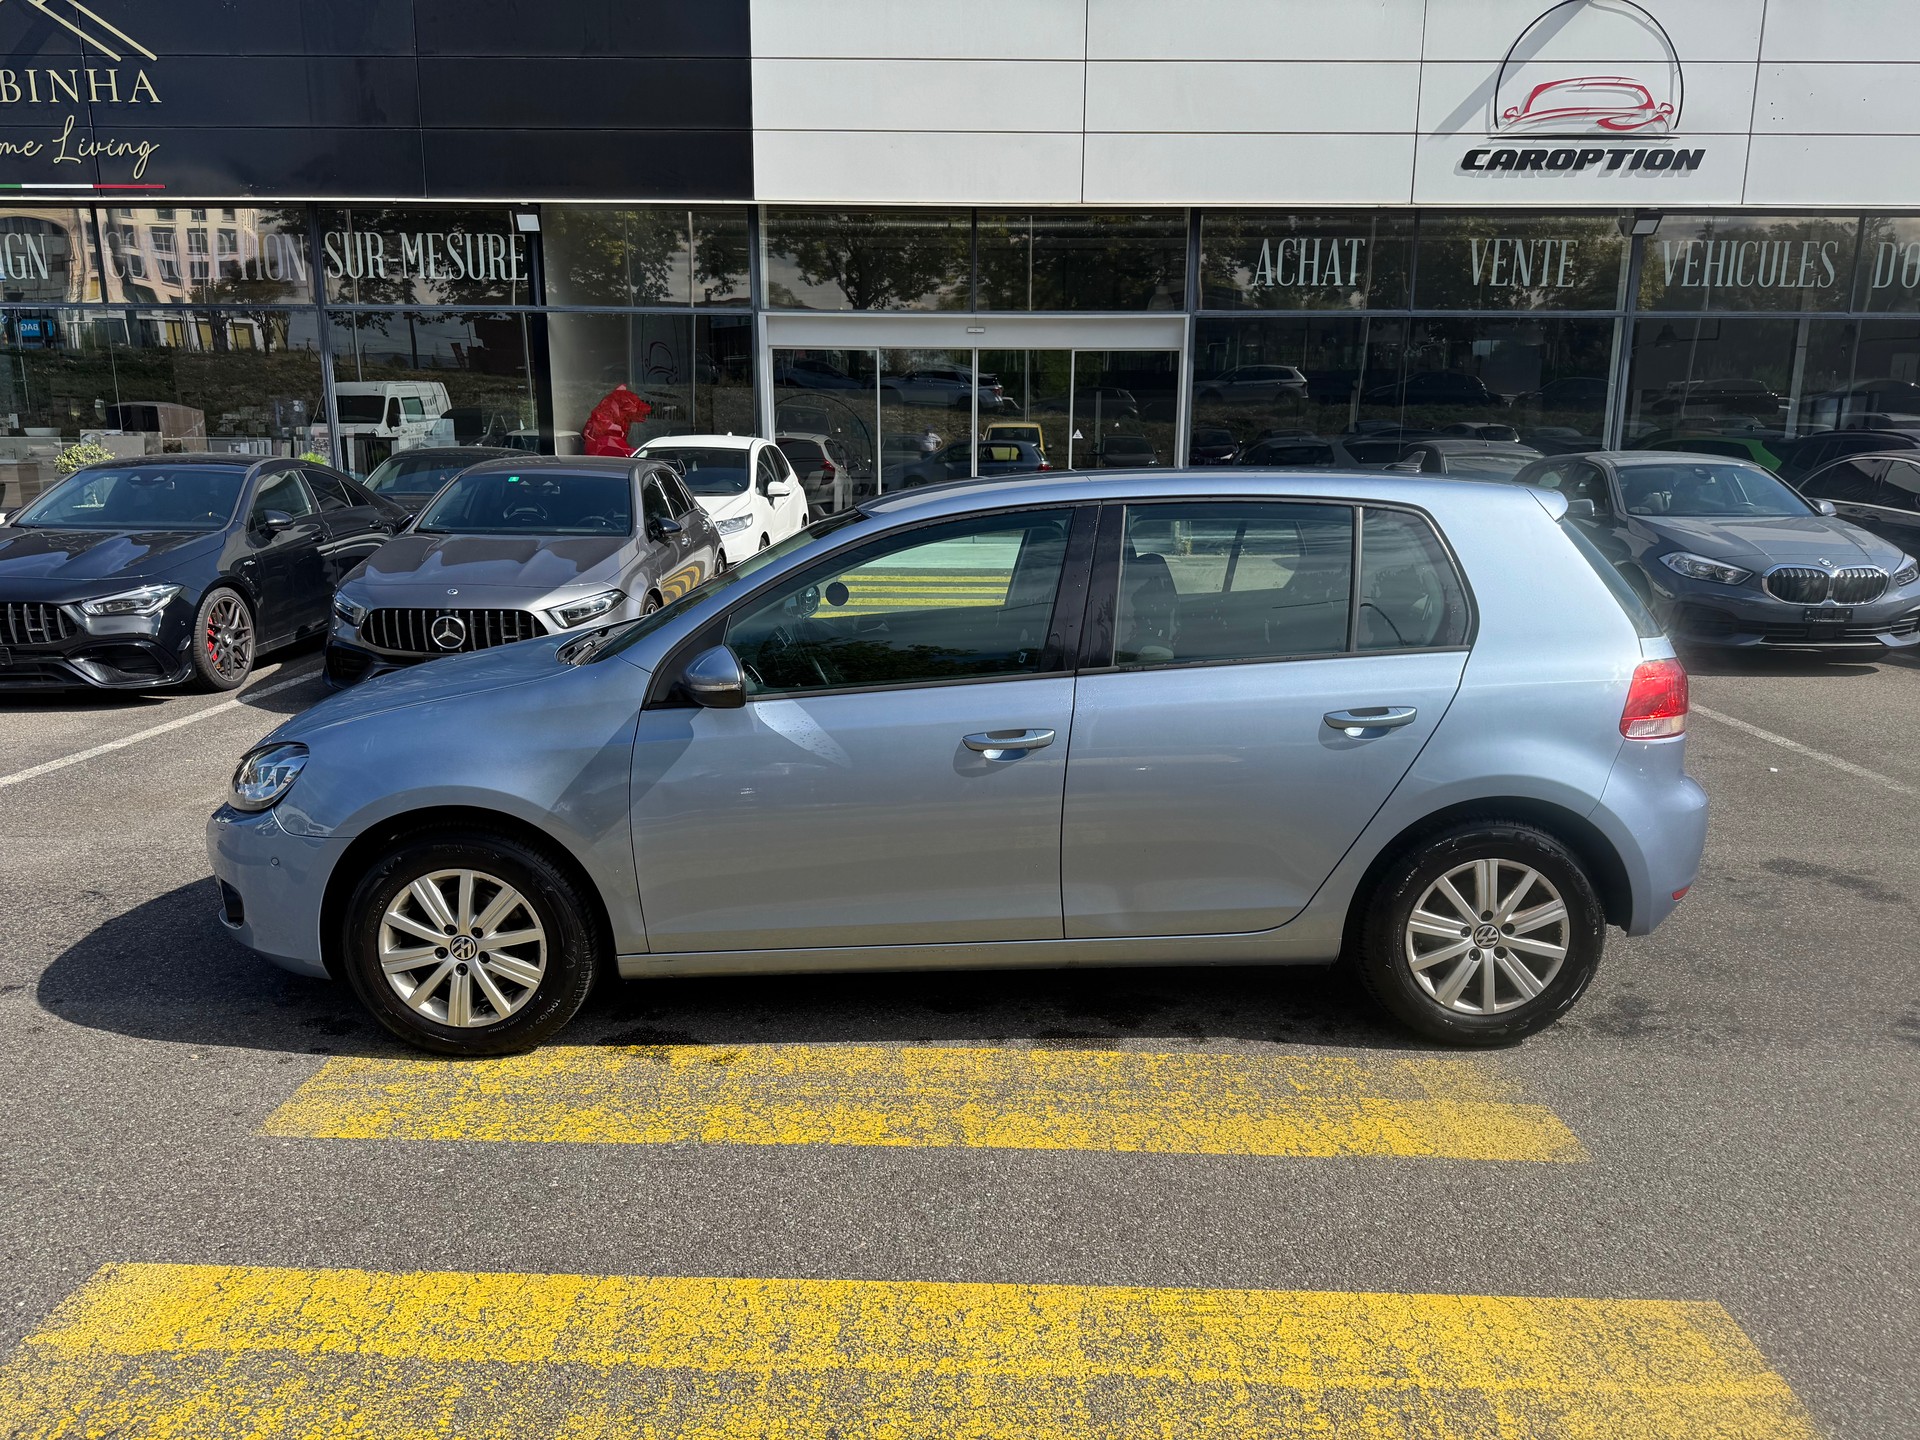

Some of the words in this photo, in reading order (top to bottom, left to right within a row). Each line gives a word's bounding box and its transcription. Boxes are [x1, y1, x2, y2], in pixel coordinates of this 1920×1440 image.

[0, 69, 162, 103] BINHA
[52, 114, 160, 179] Living
[1461, 148, 1706, 171] CAROPTION
[105, 231, 307, 281] CONCEPTION
[324, 231, 529, 281] SUR-MESURE
[1252, 238, 1366, 287] ACHAT
[1468, 238, 1579, 288] VENTE
[1662, 240, 1839, 288] VEHICULES
